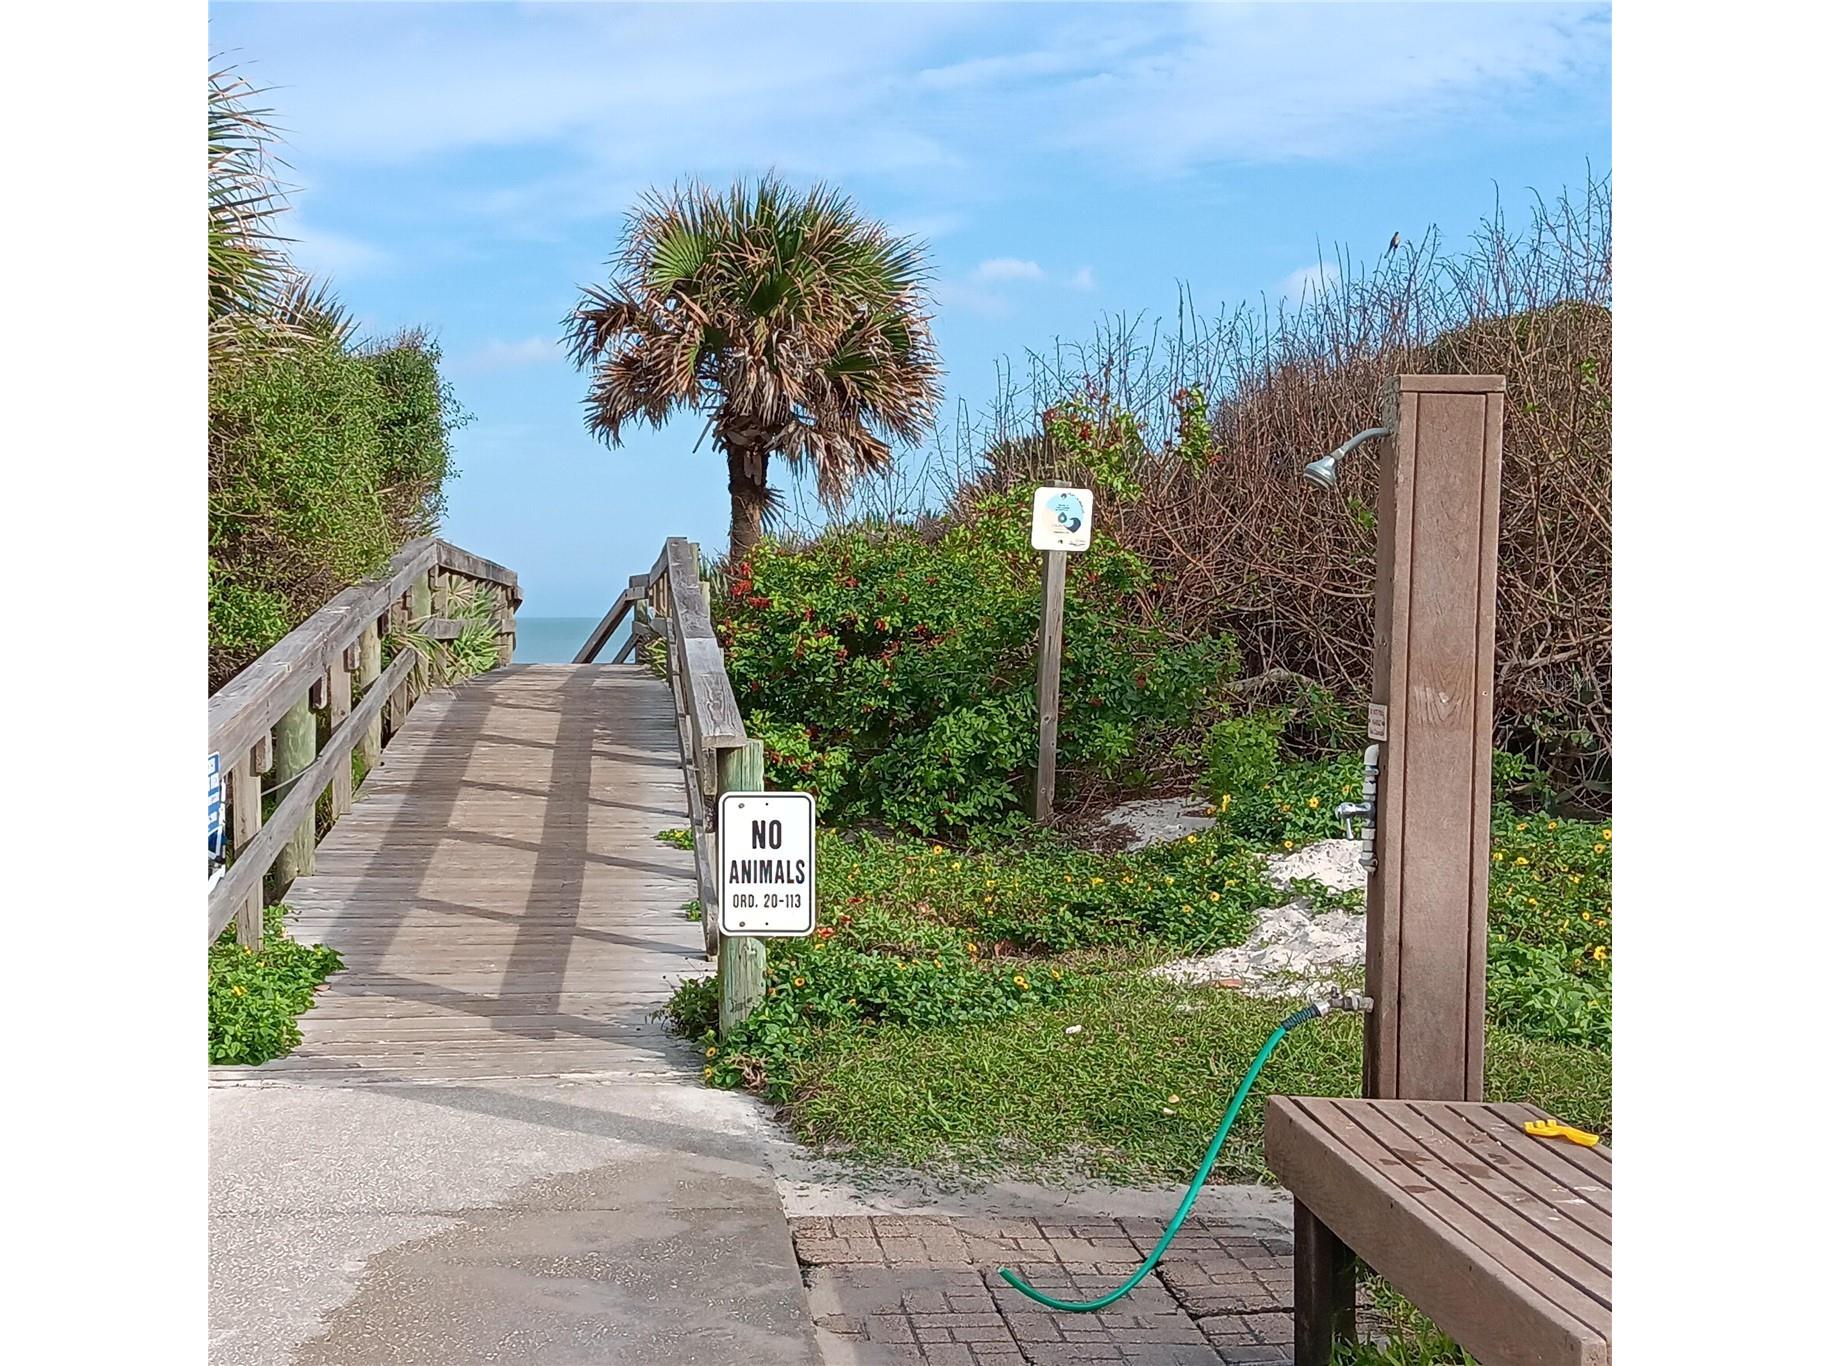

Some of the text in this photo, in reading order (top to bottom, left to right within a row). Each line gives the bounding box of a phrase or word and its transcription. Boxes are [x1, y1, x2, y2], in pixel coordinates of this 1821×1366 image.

[752, 820, 781, 849] NO
[729, 860, 805, 884] ANIMALS
[733, 894, 801, 908] ORD. 20-113
